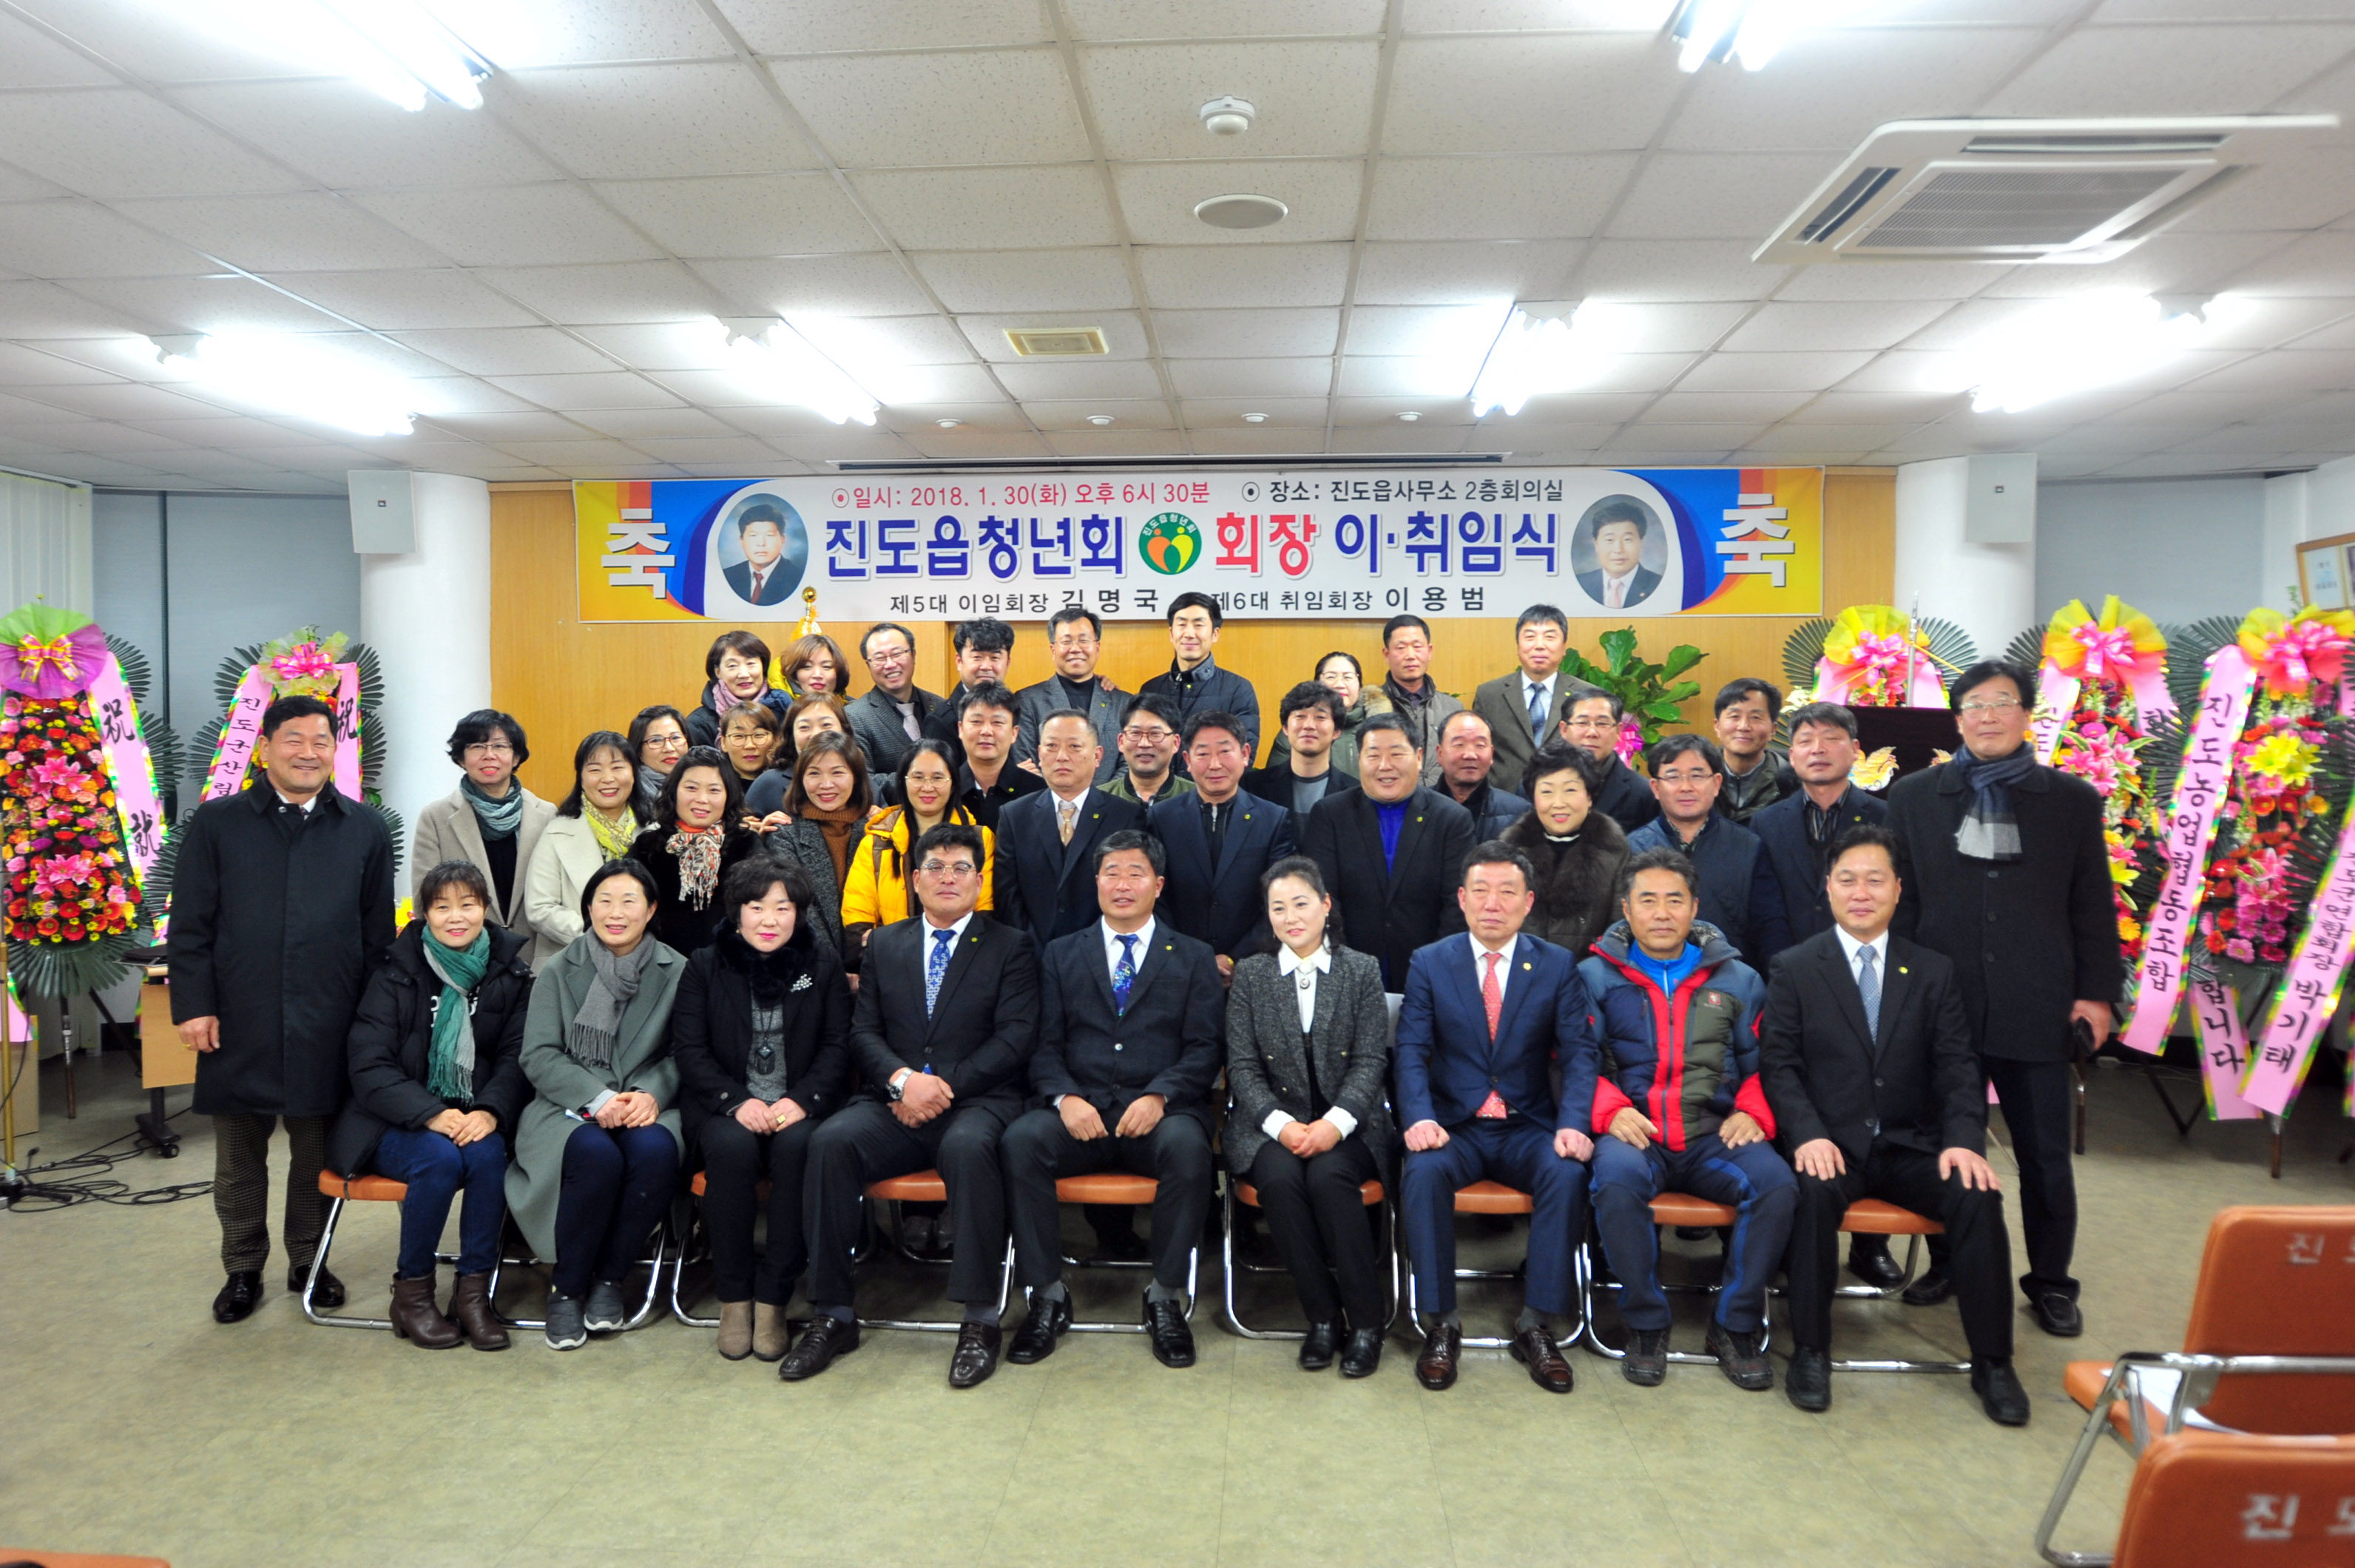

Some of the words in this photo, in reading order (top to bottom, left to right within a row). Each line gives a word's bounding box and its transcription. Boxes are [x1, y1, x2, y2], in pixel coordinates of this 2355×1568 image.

[854, 487, 900, 508] 일시:
[911, 486, 968, 507] 2018.
[979, 486, 996, 507] 1.
[1004, 482, 1067, 507] 30(화)
[1075, 482, 1115, 504] 오후
[1123, 481, 1155, 504] 6시
[1163, 481, 1210, 504] 30분
[1270, 480, 1319, 503] 장소:
[1330, 479, 1457, 502] 진도읍사무소
[1464, 479, 1563, 502] 2층회의실
[601, 508, 676, 599] 축
[826, 513, 1123, 579] 진도읍청년회
[1216, 512, 1317, 576] 회장
[1334, 511, 1555, 573] 이·취임식
[1716, 493, 1796, 588] 축
[891, 593, 947, 614] 제5대
[959, 592, 1049, 614] 이임회장
[1212, 590, 1269, 611] 제6대
[1280, 590, 1373, 611] 취임회장
